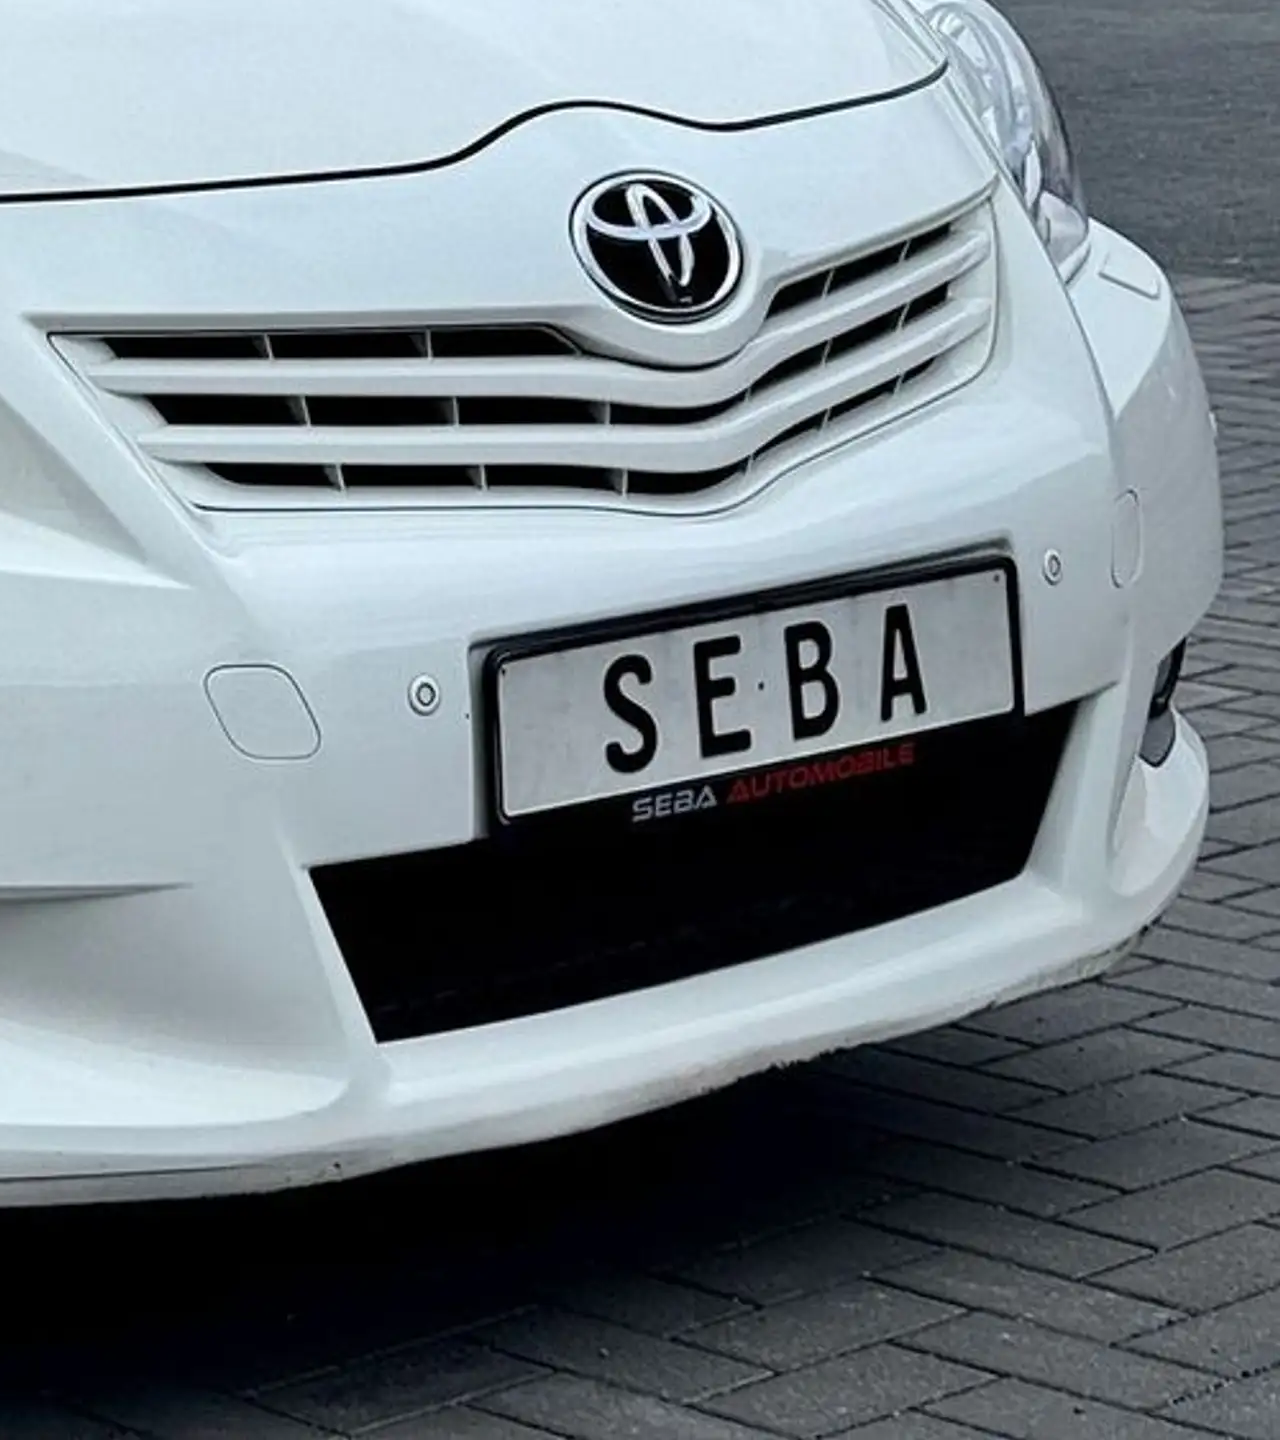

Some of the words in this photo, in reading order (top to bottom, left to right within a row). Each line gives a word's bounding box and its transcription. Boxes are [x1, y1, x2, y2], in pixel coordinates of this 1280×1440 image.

[602, 602, 928, 773] SEBA
[631, 785, 718, 823] SEBA
[726, 742, 917, 805] AUTOMOBILE
